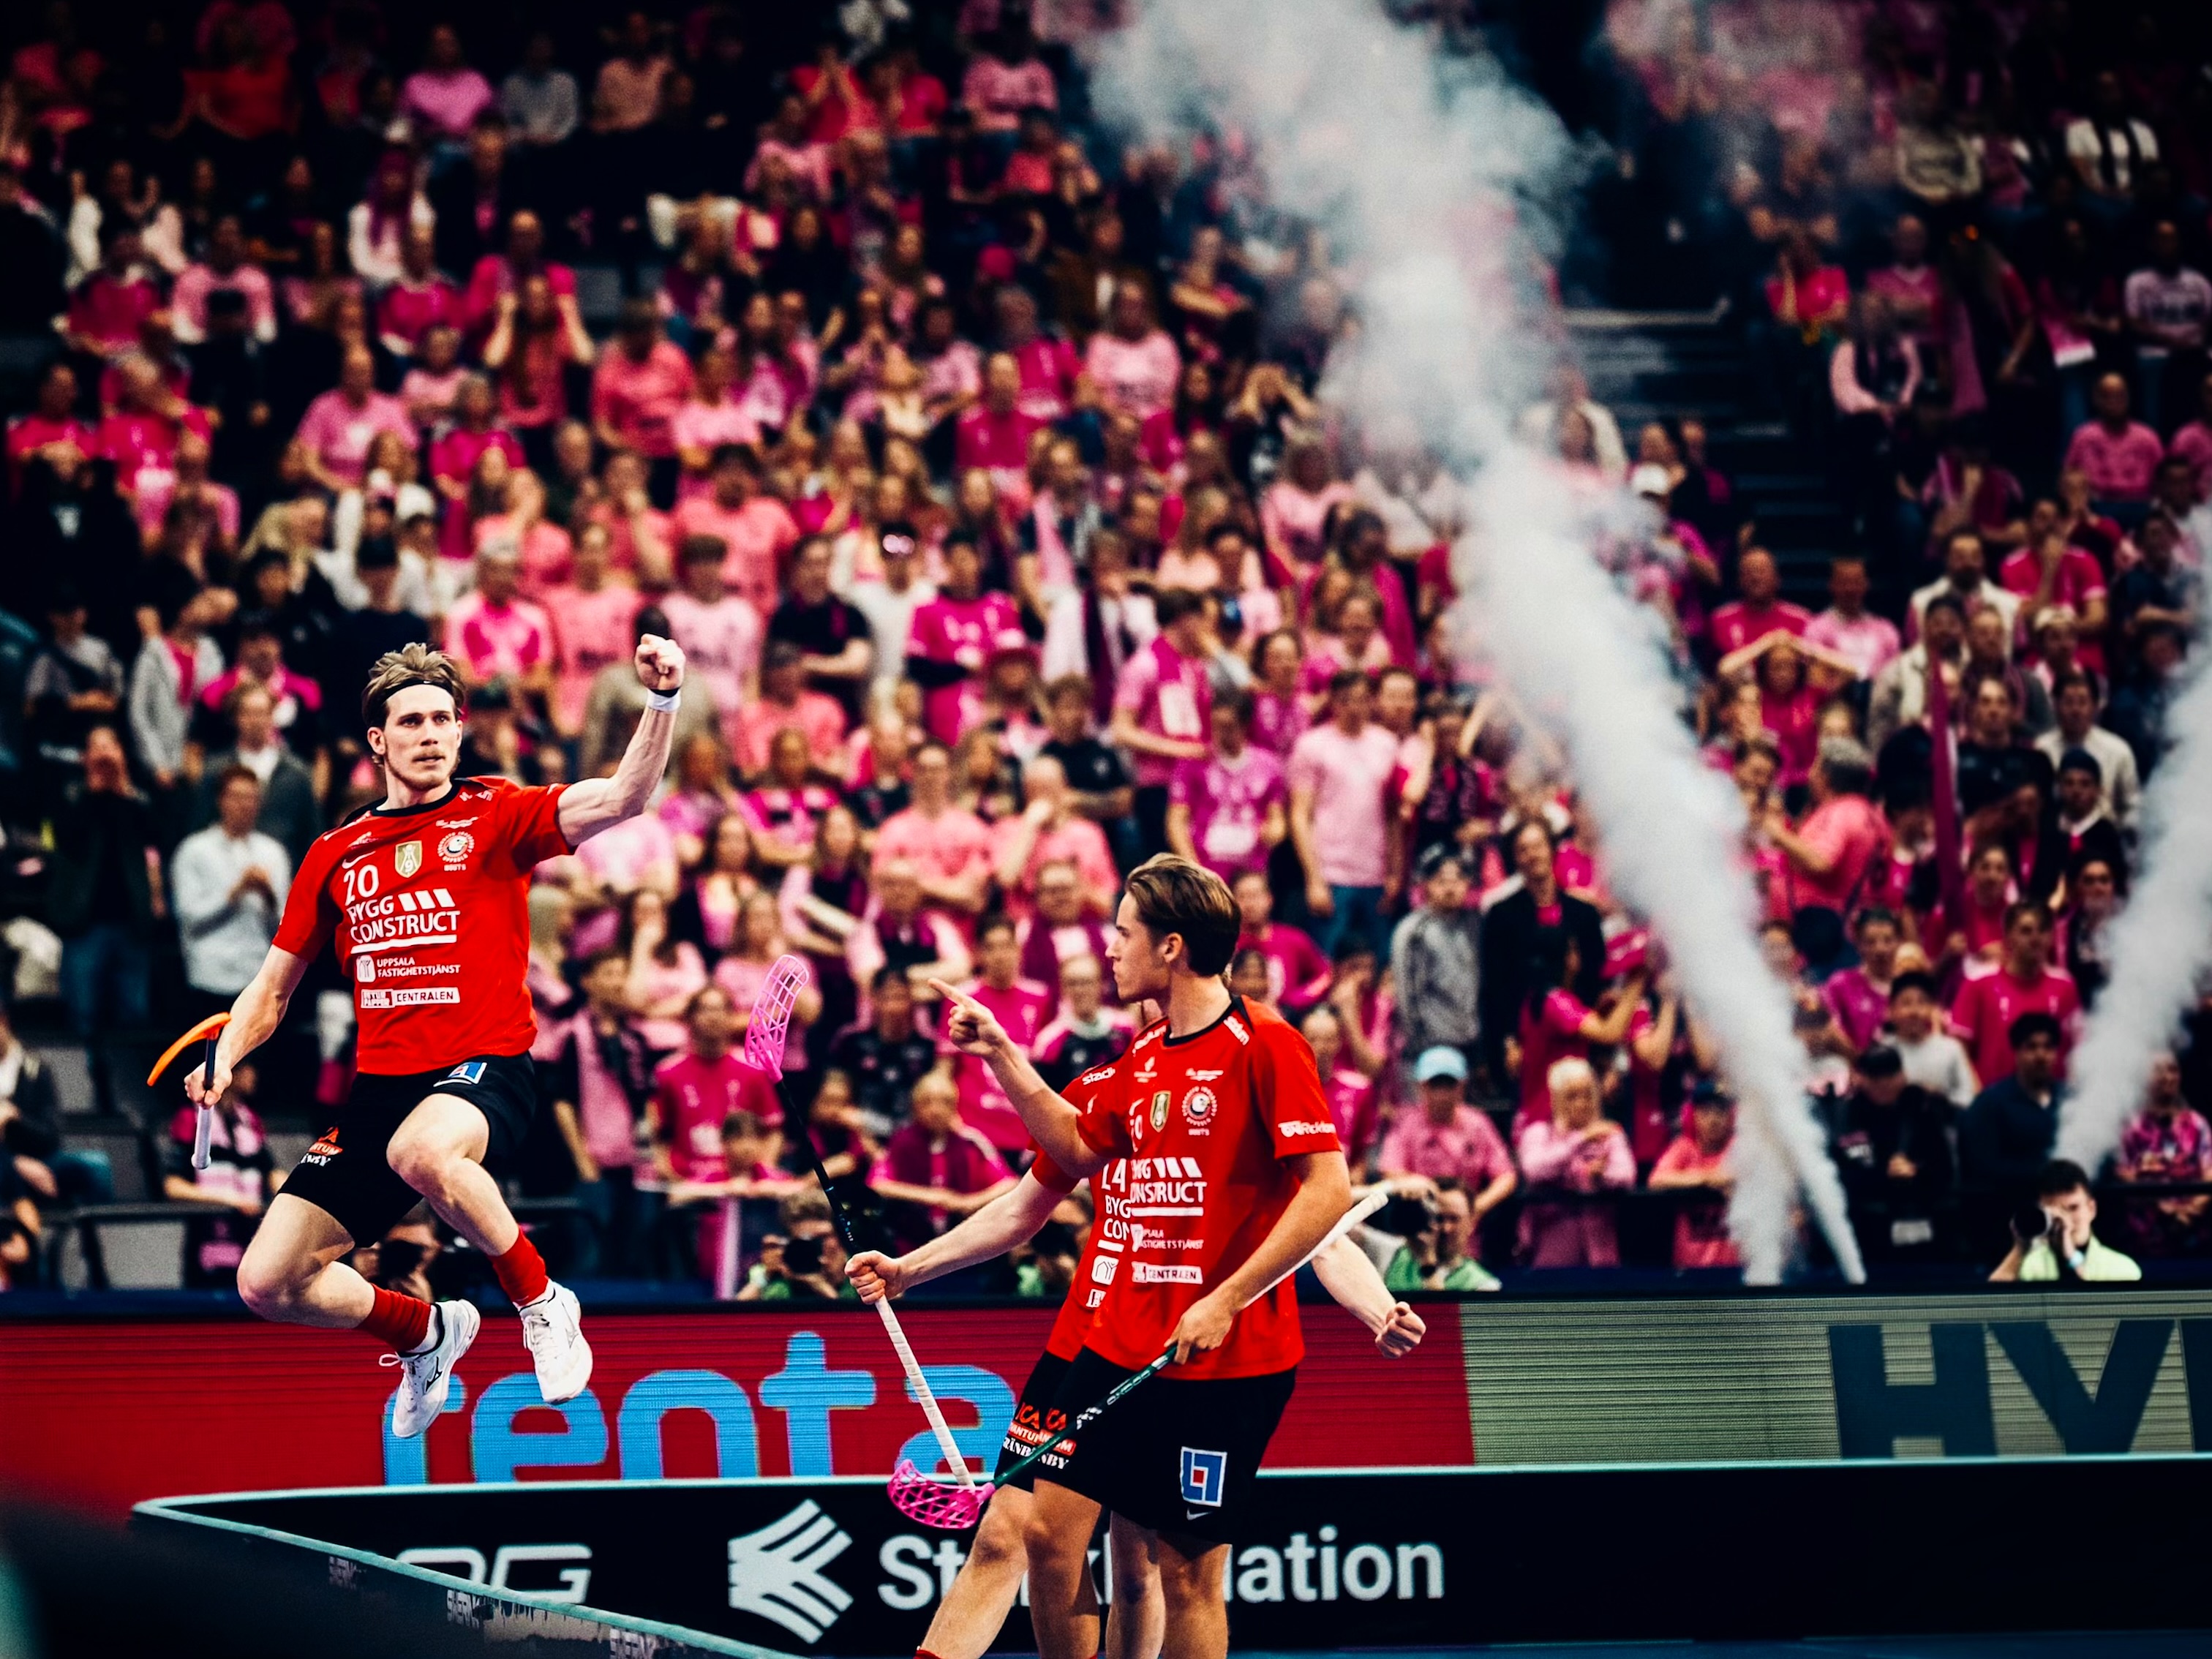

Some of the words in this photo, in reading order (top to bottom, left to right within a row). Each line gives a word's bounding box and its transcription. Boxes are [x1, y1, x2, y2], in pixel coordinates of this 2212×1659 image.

[343, 865, 380, 906] 20
[350, 910, 461, 944] CONSTRUCT
[377, 957, 415, 968] UPPSALA
[377, 964, 462, 978] FASTIGHETSTJÄNST
[396, 991, 454, 1003] CENTRALEN
[1105, 1195, 1132, 1219] BYG
[383, 1331, 1017, 1486] renta
